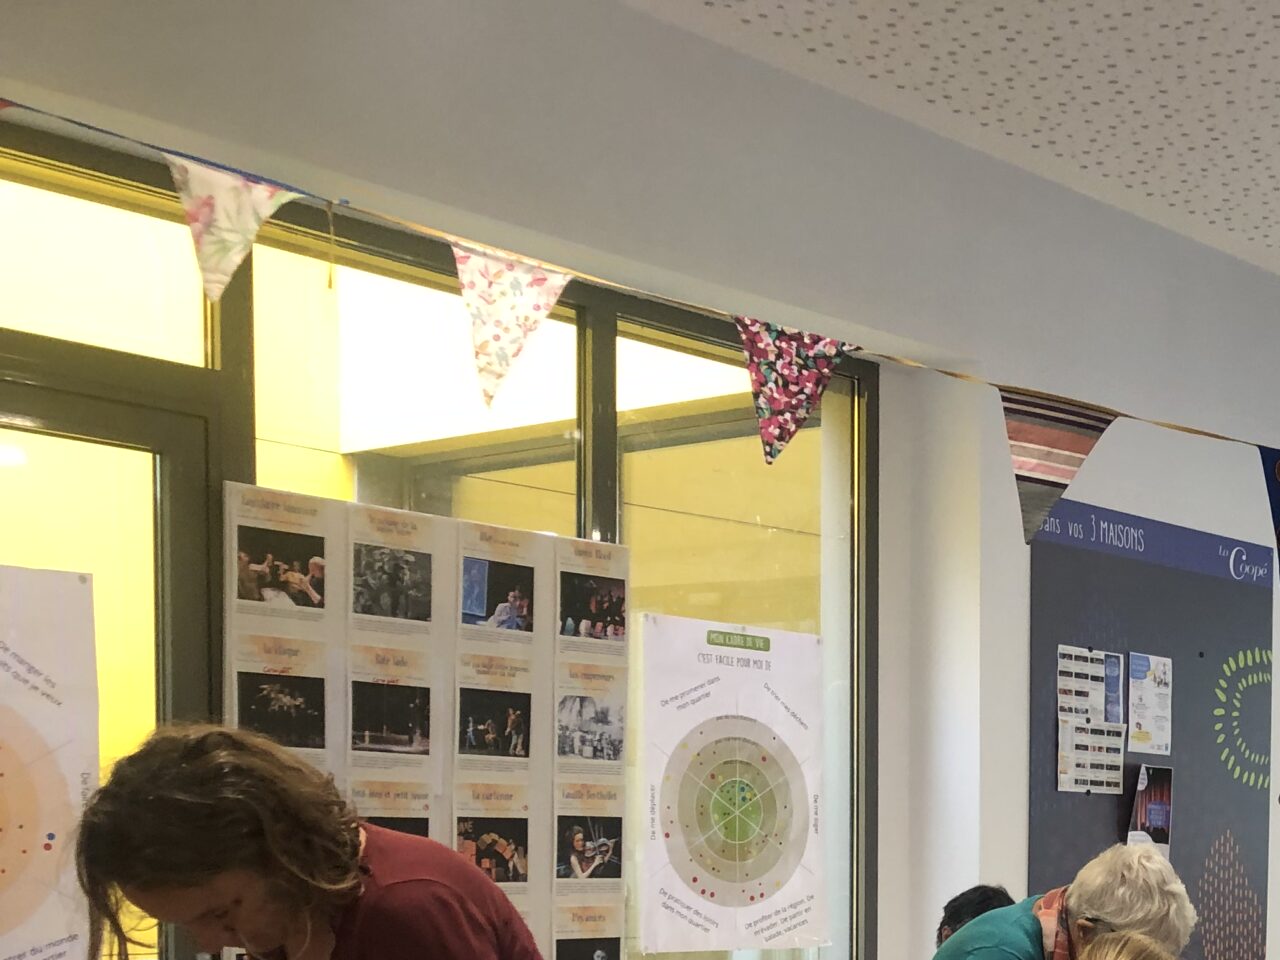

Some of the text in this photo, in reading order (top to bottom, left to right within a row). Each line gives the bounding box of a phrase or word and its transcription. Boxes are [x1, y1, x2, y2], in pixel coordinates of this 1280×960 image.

[1040, 514, 1145, 552] ans vos 3 MAISONS
[1229, 546, 1268, 581] Coopé
[698, 652, 772, 671] C'EST FACILE POUR MOI DE
